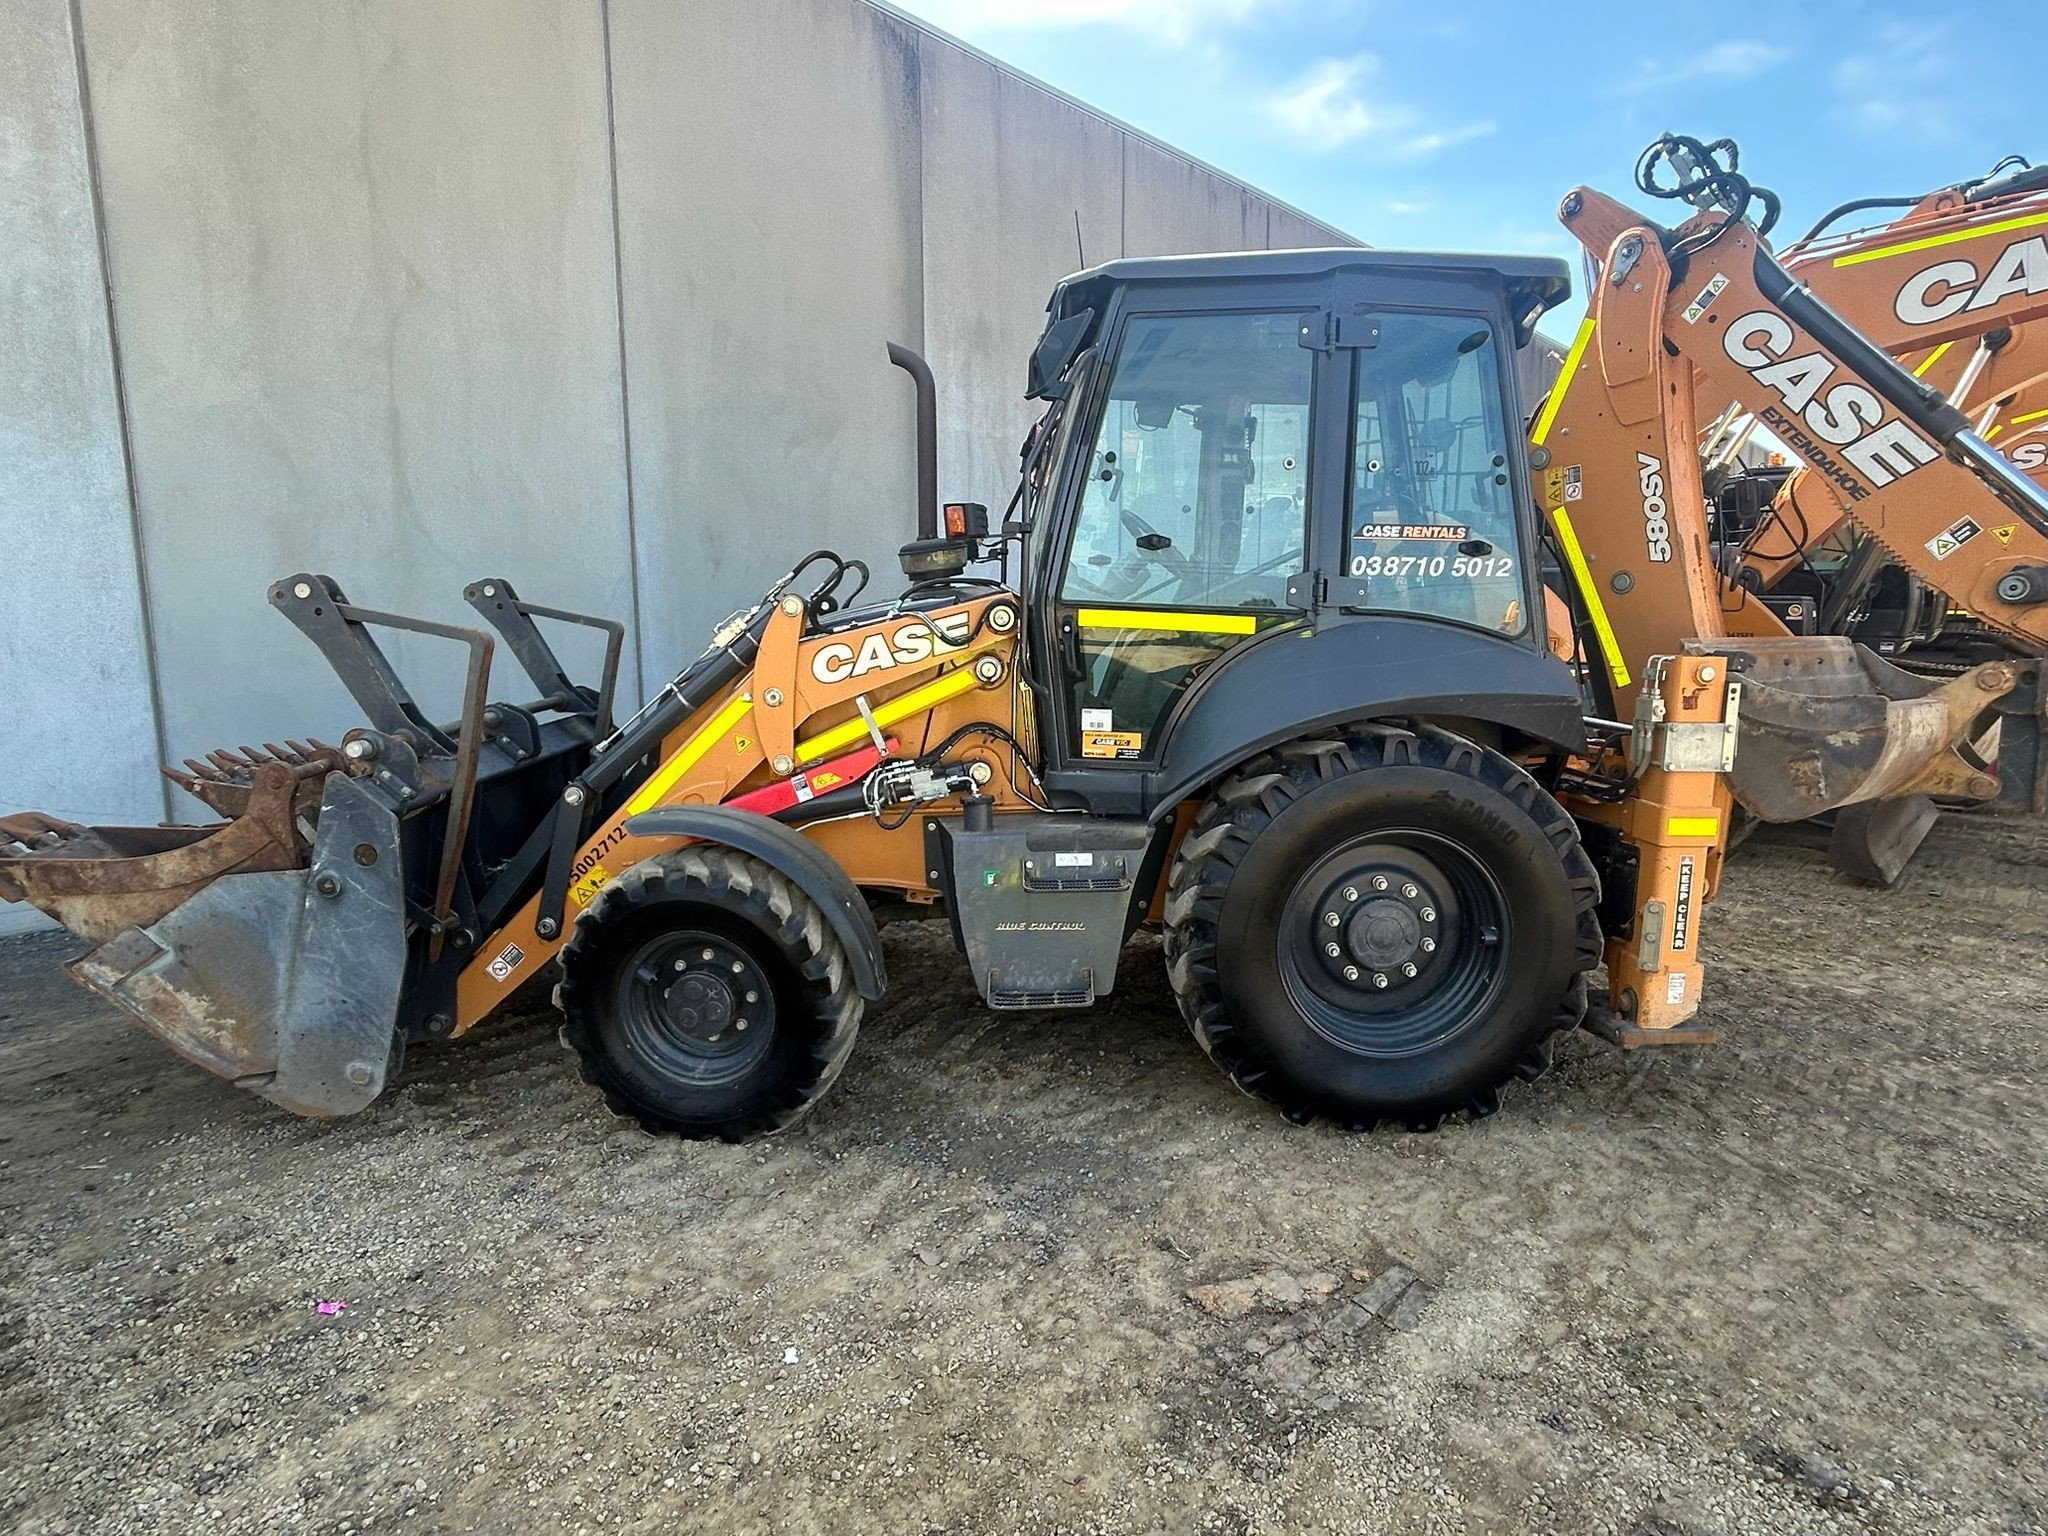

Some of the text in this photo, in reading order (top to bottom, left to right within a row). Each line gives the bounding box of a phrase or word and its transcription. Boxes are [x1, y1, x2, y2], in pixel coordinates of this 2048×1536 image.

[1722, 310, 1943, 490] CASE
[1760, 406, 1871, 501] EXTENDAHOE
[1362, 524, 1466, 539] CASE RENTALS
[1636, 450, 1672, 563] 580SV
[1350, 555, 1513, 577] 038710 5012
[811, 610, 970, 684] CASE
[568, 820, 627, 888] 5002712
[1028, 921, 1087, 931] CONTROL
[1674, 865, 1692, 948] KEEP CLEAR
